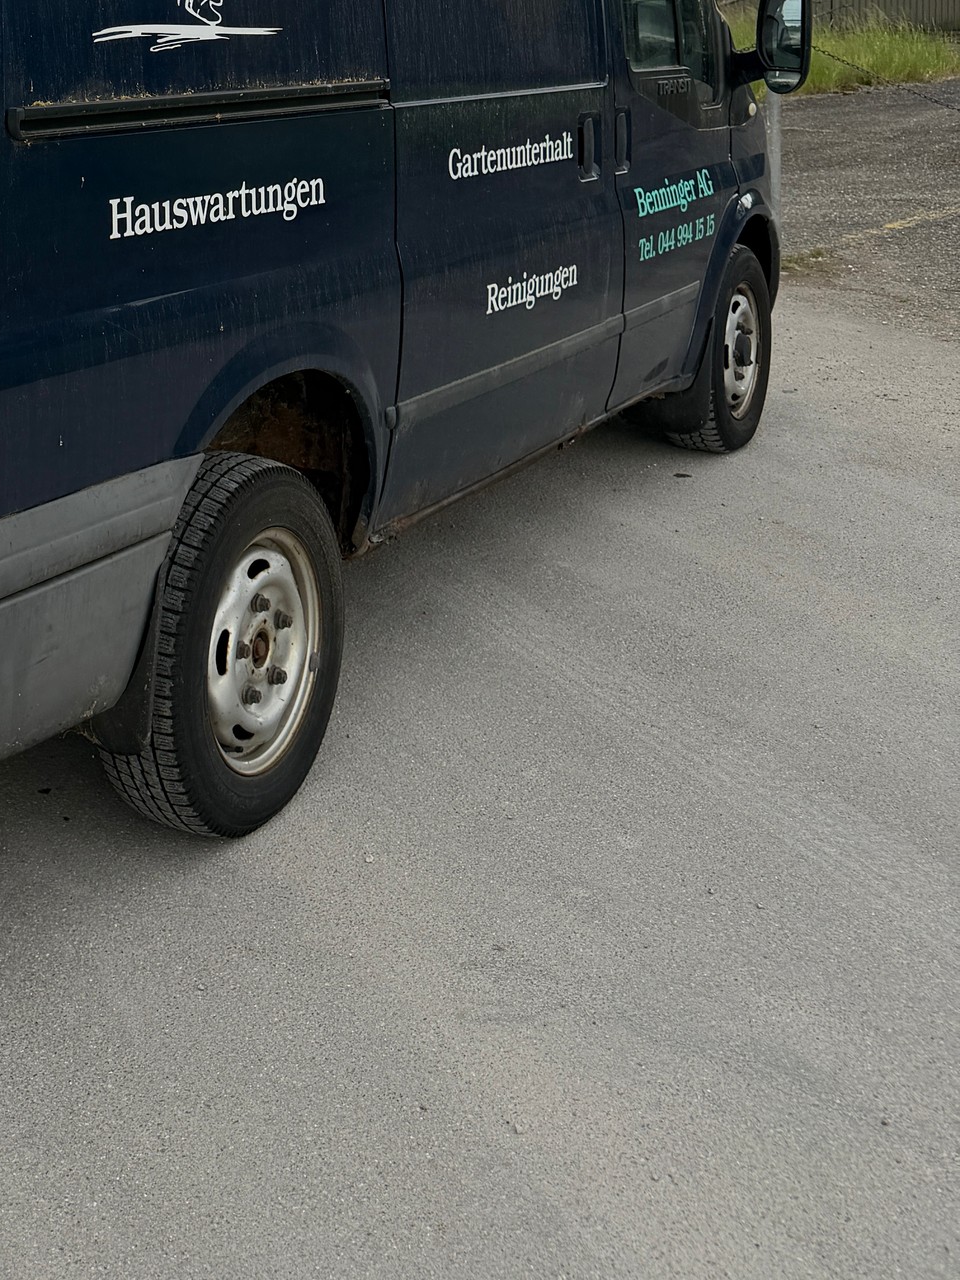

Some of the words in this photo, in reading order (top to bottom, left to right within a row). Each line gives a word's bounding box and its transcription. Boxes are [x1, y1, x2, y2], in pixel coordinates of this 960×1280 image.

[657, 77, 692, 95] TRANSIT
[448, 131, 574, 180] Gartenunterhalt
[108, 177, 326, 240] Hauswartungen
[633, 177, 697, 218] Benninger
[696, 168, 714, 199] AG
[639, 235, 656, 261] Tel.
[658, 227, 675, 255] 044
[677, 221, 693, 248] 994
[695, 217, 705, 241] 15
[705, 213, 715, 237] 15
[485, 264, 578, 315] Reinigungen
